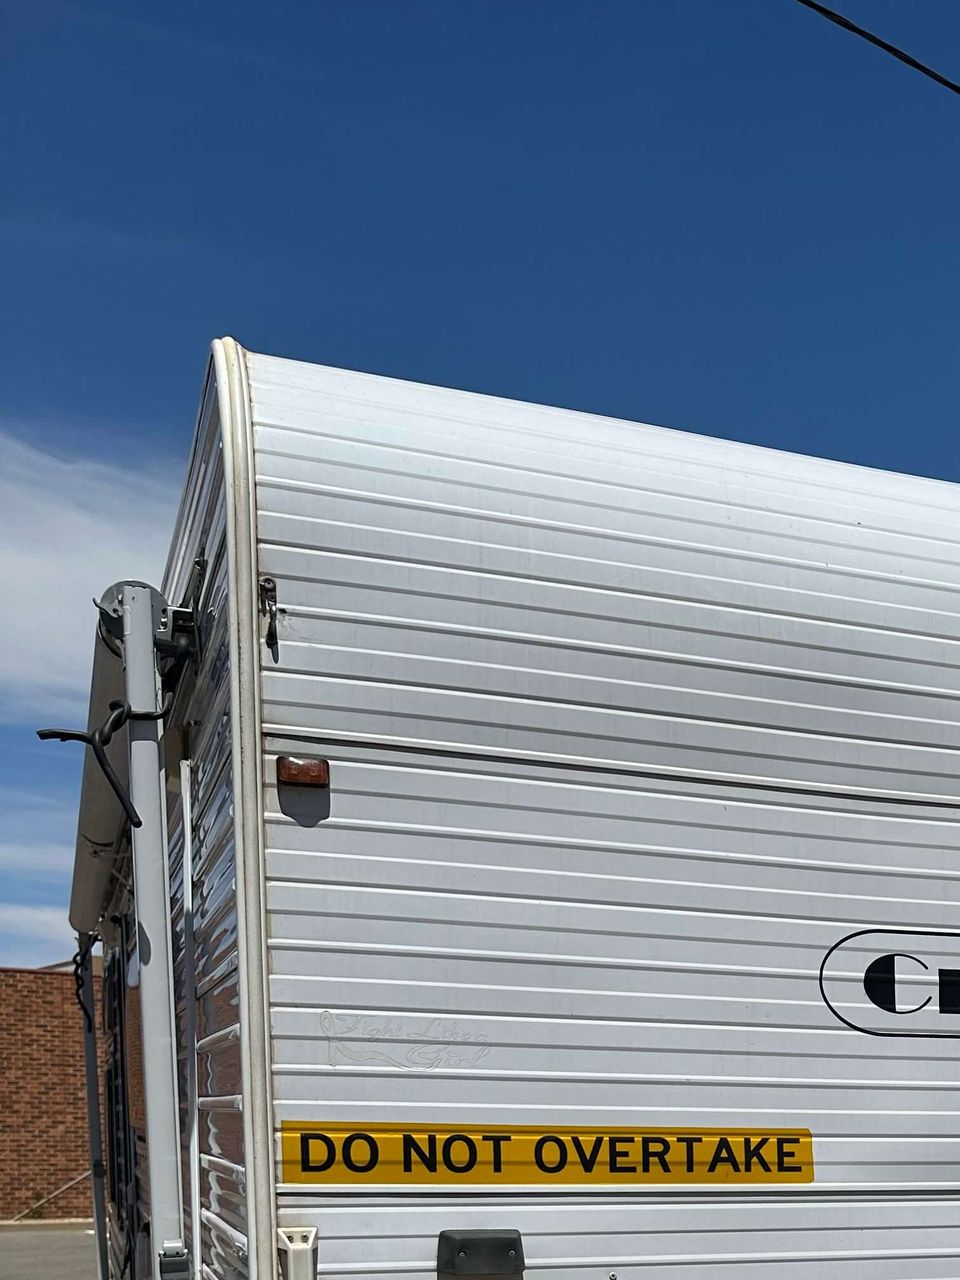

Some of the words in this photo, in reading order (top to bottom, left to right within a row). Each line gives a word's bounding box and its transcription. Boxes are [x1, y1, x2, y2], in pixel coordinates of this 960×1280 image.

[301, 1132, 380, 1173] DO
[402, 1134, 513, 1173] NOT
[533, 1135, 803, 1173] OVERTAKE
